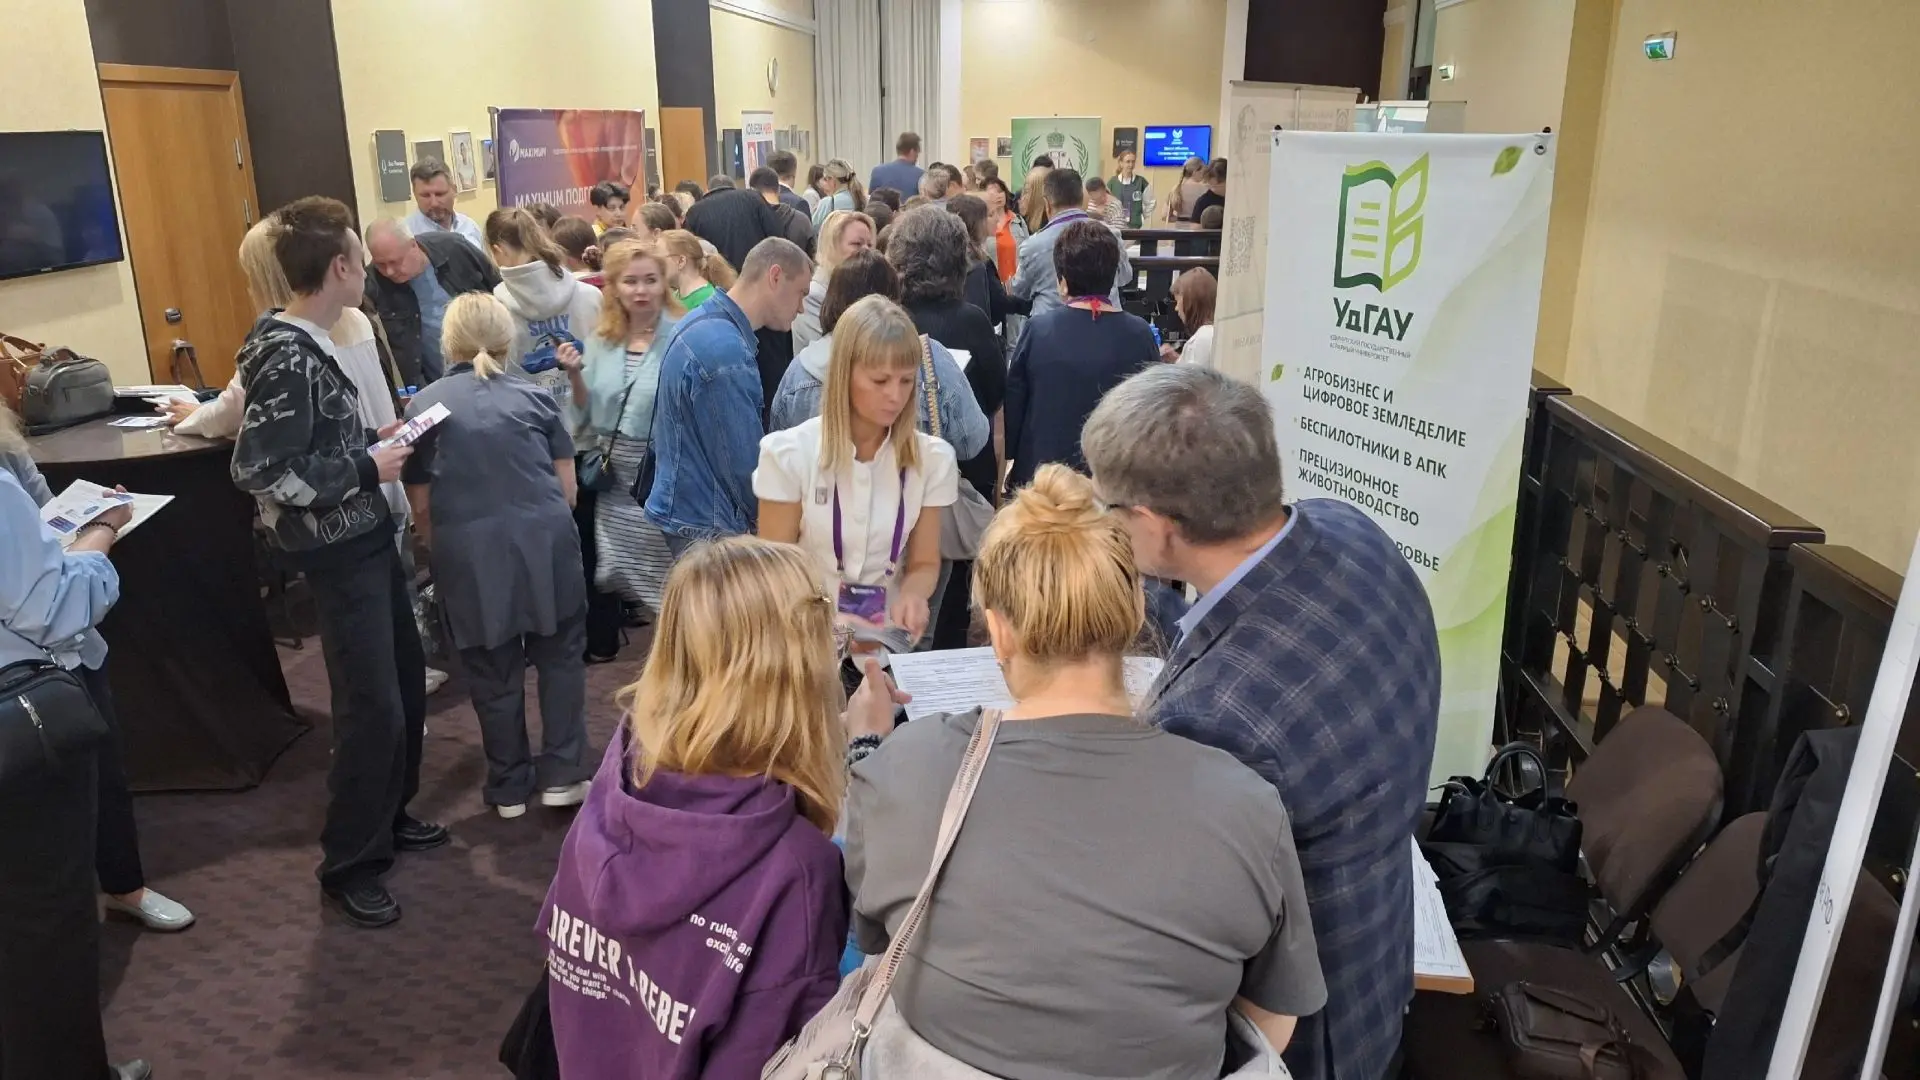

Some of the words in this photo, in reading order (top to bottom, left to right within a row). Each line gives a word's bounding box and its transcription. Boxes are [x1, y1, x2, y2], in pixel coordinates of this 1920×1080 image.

[519, 147, 547, 158] MAXIMUM
[515, 189, 564, 209] MAXIMUM
[1333, 297, 1414, 342] УдГАУ
[1304, 366, 1380, 400] АГРОБИЗНЕС
[1384, 388, 1394, 404] И
[1303, 384, 1369, 417] ЦИФРОВОЕ
[1372, 402, 1466, 447] ЗЕМЛЕДЕЛИЕ
[1300, 416, 1400, 463] БЕСПИЛОТНИКИ
[1403, 452, 1412, 467] В
[1416, 456, 1447, 479] АПК
[1300, 448, 1399, 498] ПРЕЦИЗИОННОЕ
[1298, 466, 1420, 526] ЖИВОТНОВОДСТВО
[1396, 541, 1440, 572] РОВЬЕ
[547, 904, 621, 980] OREVER
[690, 914, 706, 927] no
[737, 942, 753, 957] an
[568, 962, 574, 971] to
[575, 966, 590, 977] deal
[570, 973, 580, 984] you
[582, 979, 601, 989] want
[603, 984, 611, 992] to
[725, 953, 744, 973] life
